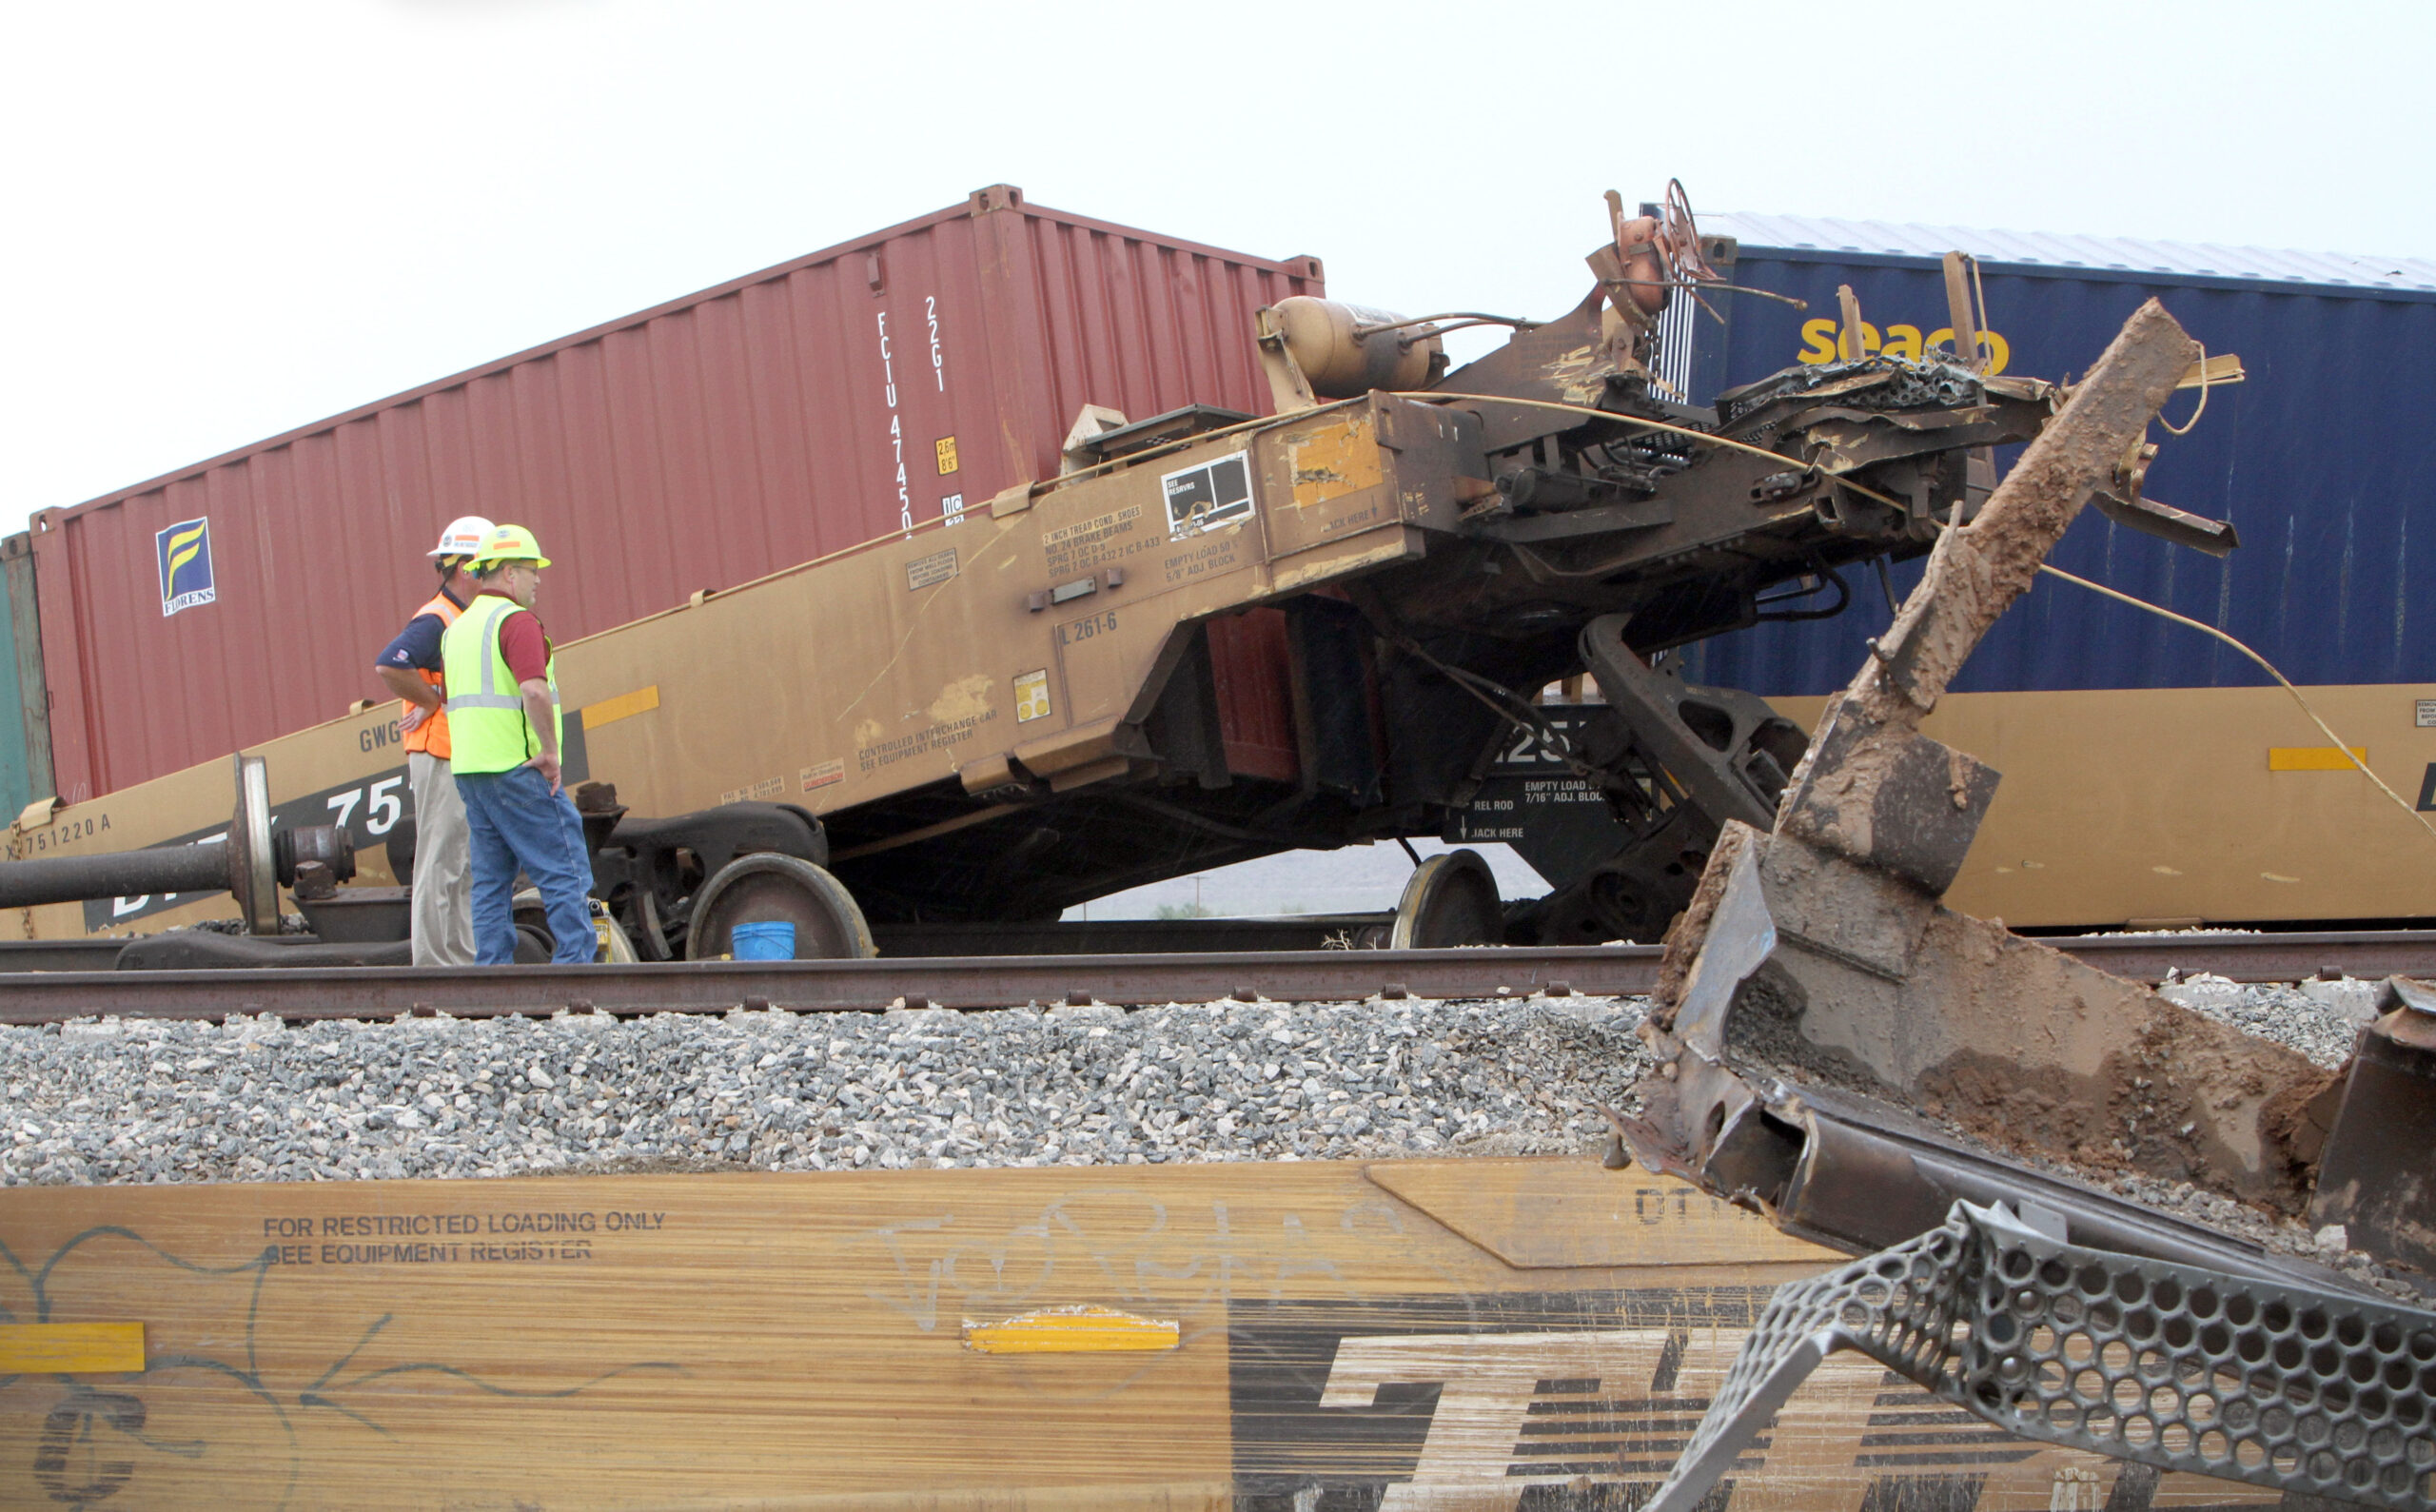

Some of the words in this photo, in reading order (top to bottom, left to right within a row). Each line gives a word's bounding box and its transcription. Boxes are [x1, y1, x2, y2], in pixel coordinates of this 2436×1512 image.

[926, 296, 943, 391] 22G1
[877, 312, 896, 407] FCIU
[890, 415, 913, 540] 47450
[1167, 479, 1179, 488] SEE
[1051, 530, 1068, 542] INCH
[1071, 520, 1092, 536] TREAD
[1117, 506, 1140, 521] SHOES
[1072, 529, 1101, 548] BRAKE
[1102, 520, 1133, 539] BEAMS
[1165, 552, 1194, 570] EMPTY
[1196, 543, 1218, 560] LOAD
[1208, 553, 1235, 570] BLOCK
[165, 591, 214, 614] FLORENS
[1061, 627, 1071, 645] L
[1074, 612, 1117, 641] 261-6
[858, 736, 914, 760] CONTROLLED
[915, 716, 976, 742] INTERCHANGE
[980, 709, 997, 723] CAR
[860, 759, 875, 772] SEE
[878, 743, 928, 766] EQUIPMENT
[931, 729, 973, 749] REGISTER
[1524, 780, 1558, 792] EMPTY
[1561, 780, 1586, 791] LOAD
[1525, 792, 1551, 803] 7/16"
[1554, 792, 1576, 802] ADJ.
[1579, 792, 1605, 802] BLOC
[327, 776, 415, 835] 75
[1475, 800, 1492, 811] REL
[1494, 800, 1514, 810] ROD
[27, 818, 94, 854] 751220
[101, 814, 111, 831] A
[1499, 828, 1523, 837] HERE
[264, 1217, 314, 1238] FOR
[323, 1213, 480, 1236] RESTRICTED
[487, 1212, 597, 1234] LOADING
[605, 1211, 665, 1231] ONLY
[265, 1245, 313, 1266] SEE
[322, 1243, 462, 1265] EQUIPMENT
[470, 1240, 592, 1262] REGISTER
